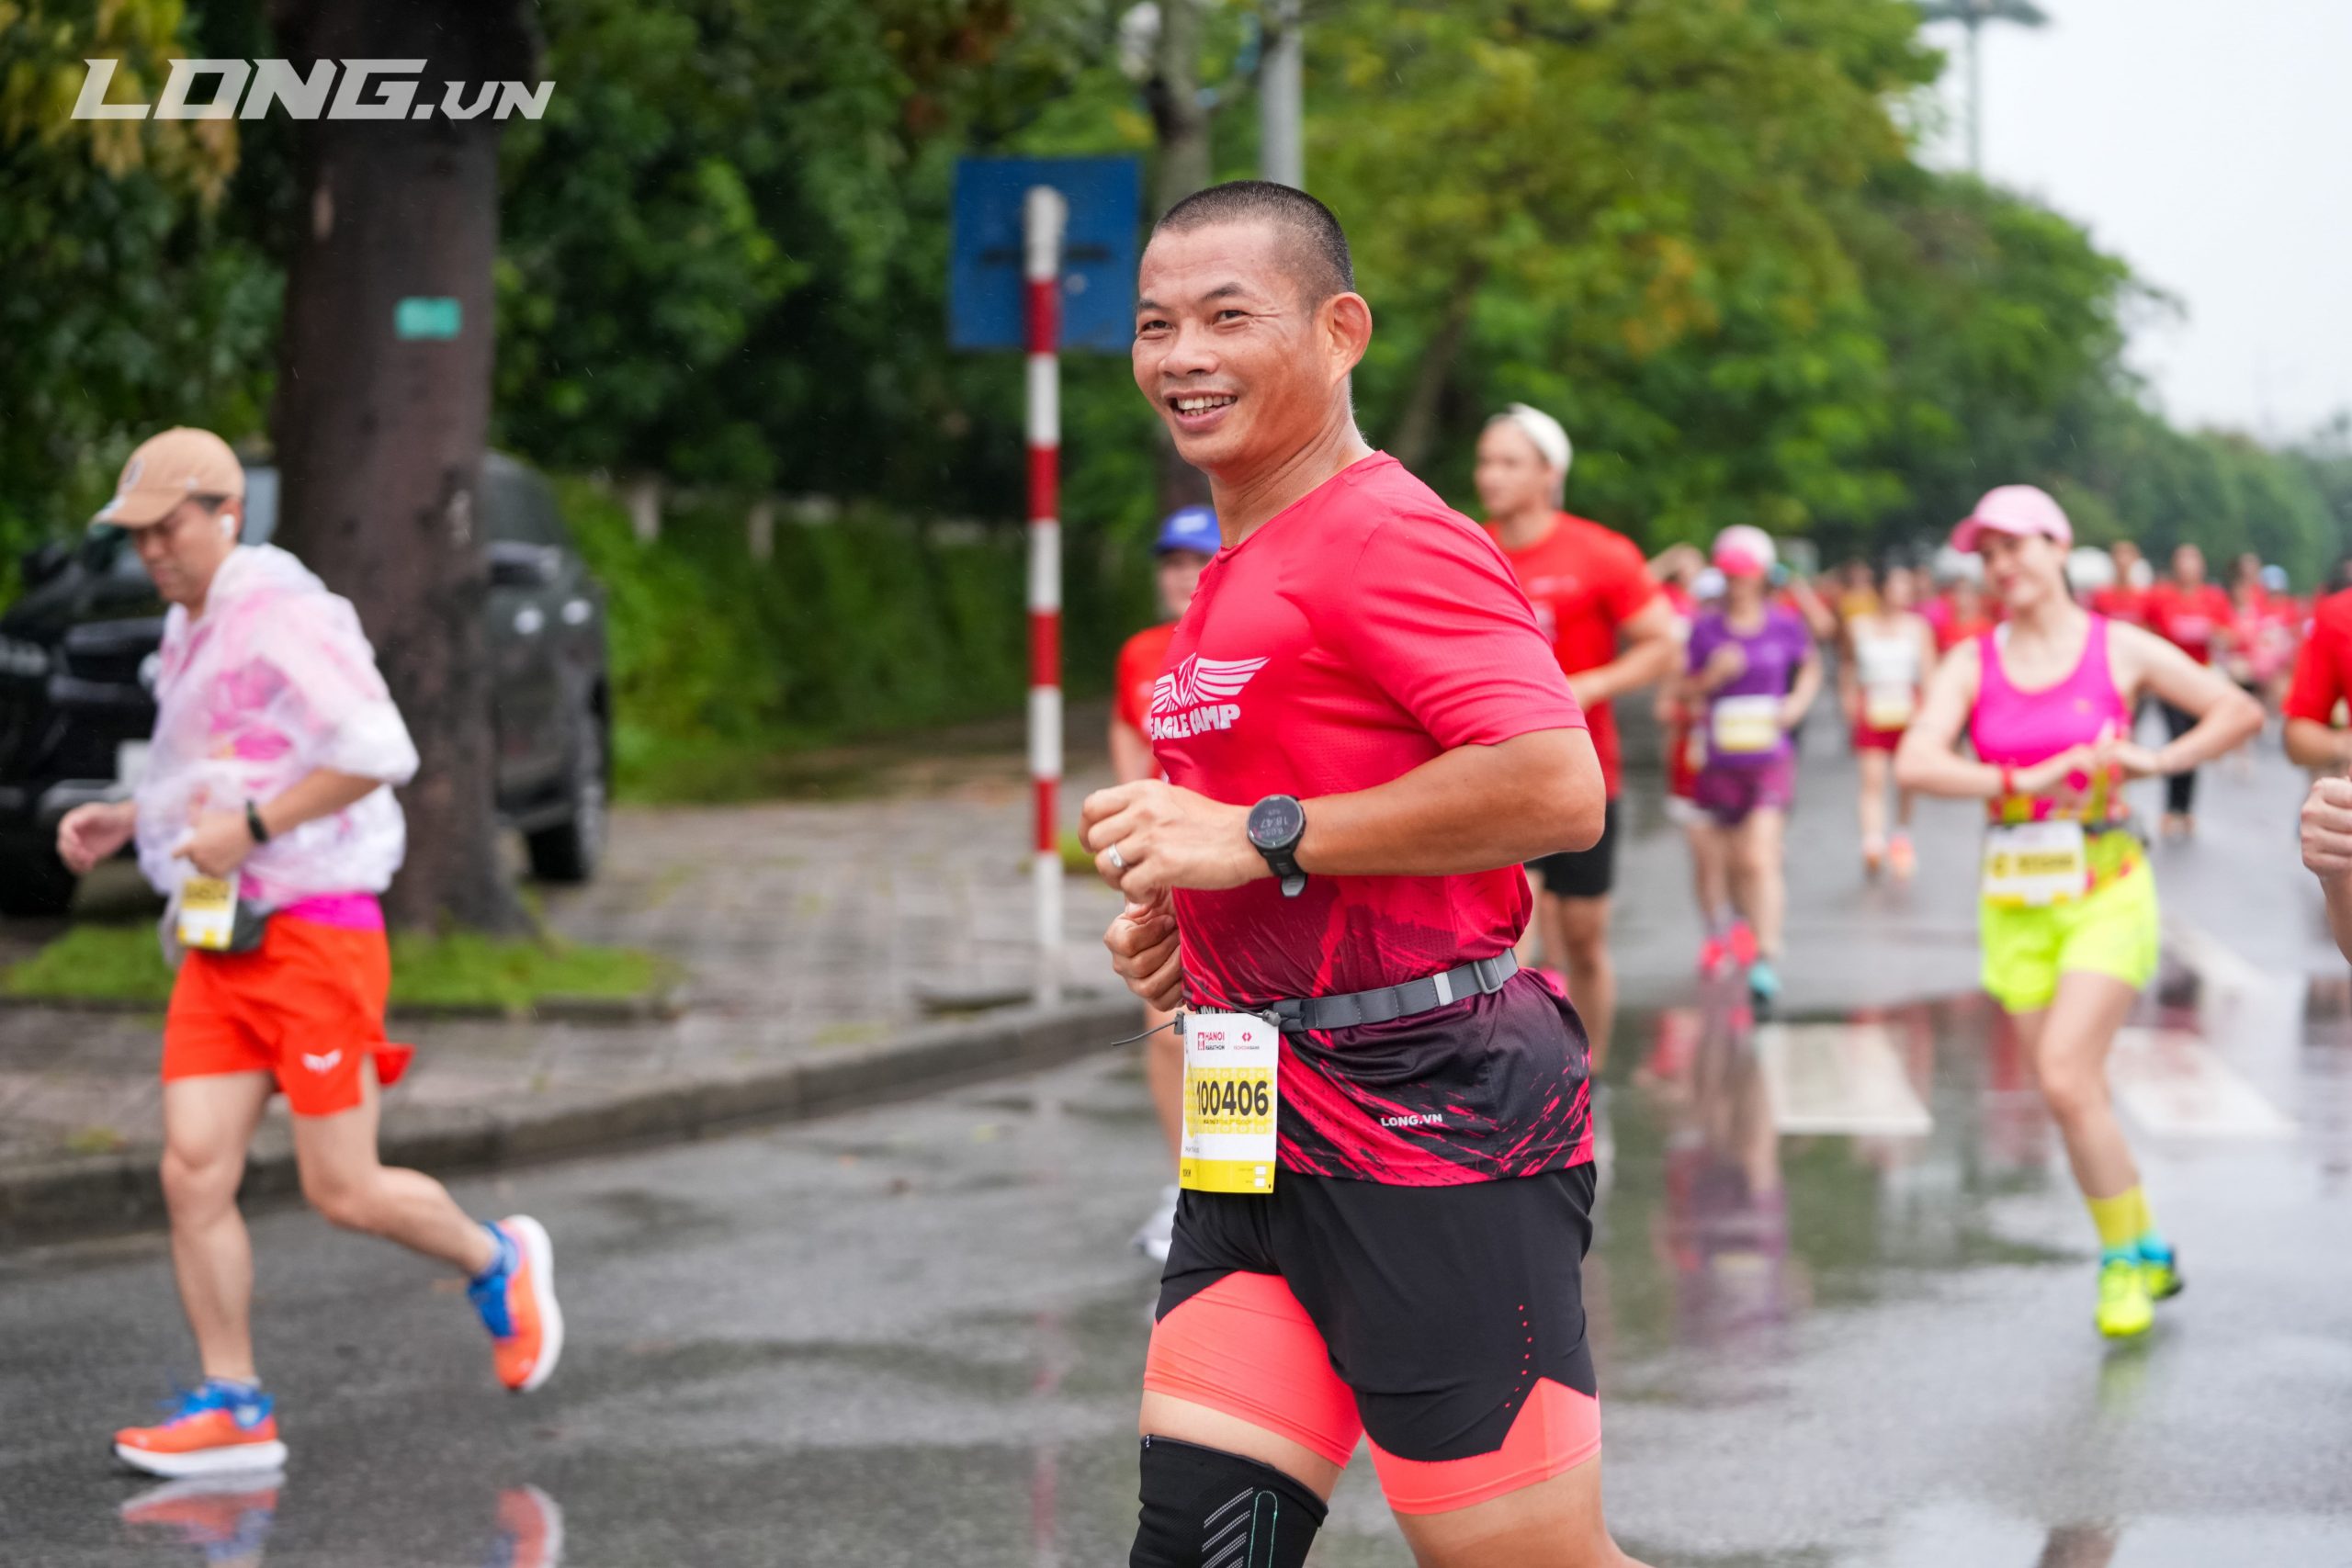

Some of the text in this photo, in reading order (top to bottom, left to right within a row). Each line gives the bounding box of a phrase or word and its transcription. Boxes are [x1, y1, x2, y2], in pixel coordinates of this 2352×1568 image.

[1190, 704, 1241, 735] CAMP
[1204, 1032, 1226, 1042] HANOI
[1196, 1080, 1269, 1116] 100406
[1380, 1113, 1443, 1127] LONG.VN
